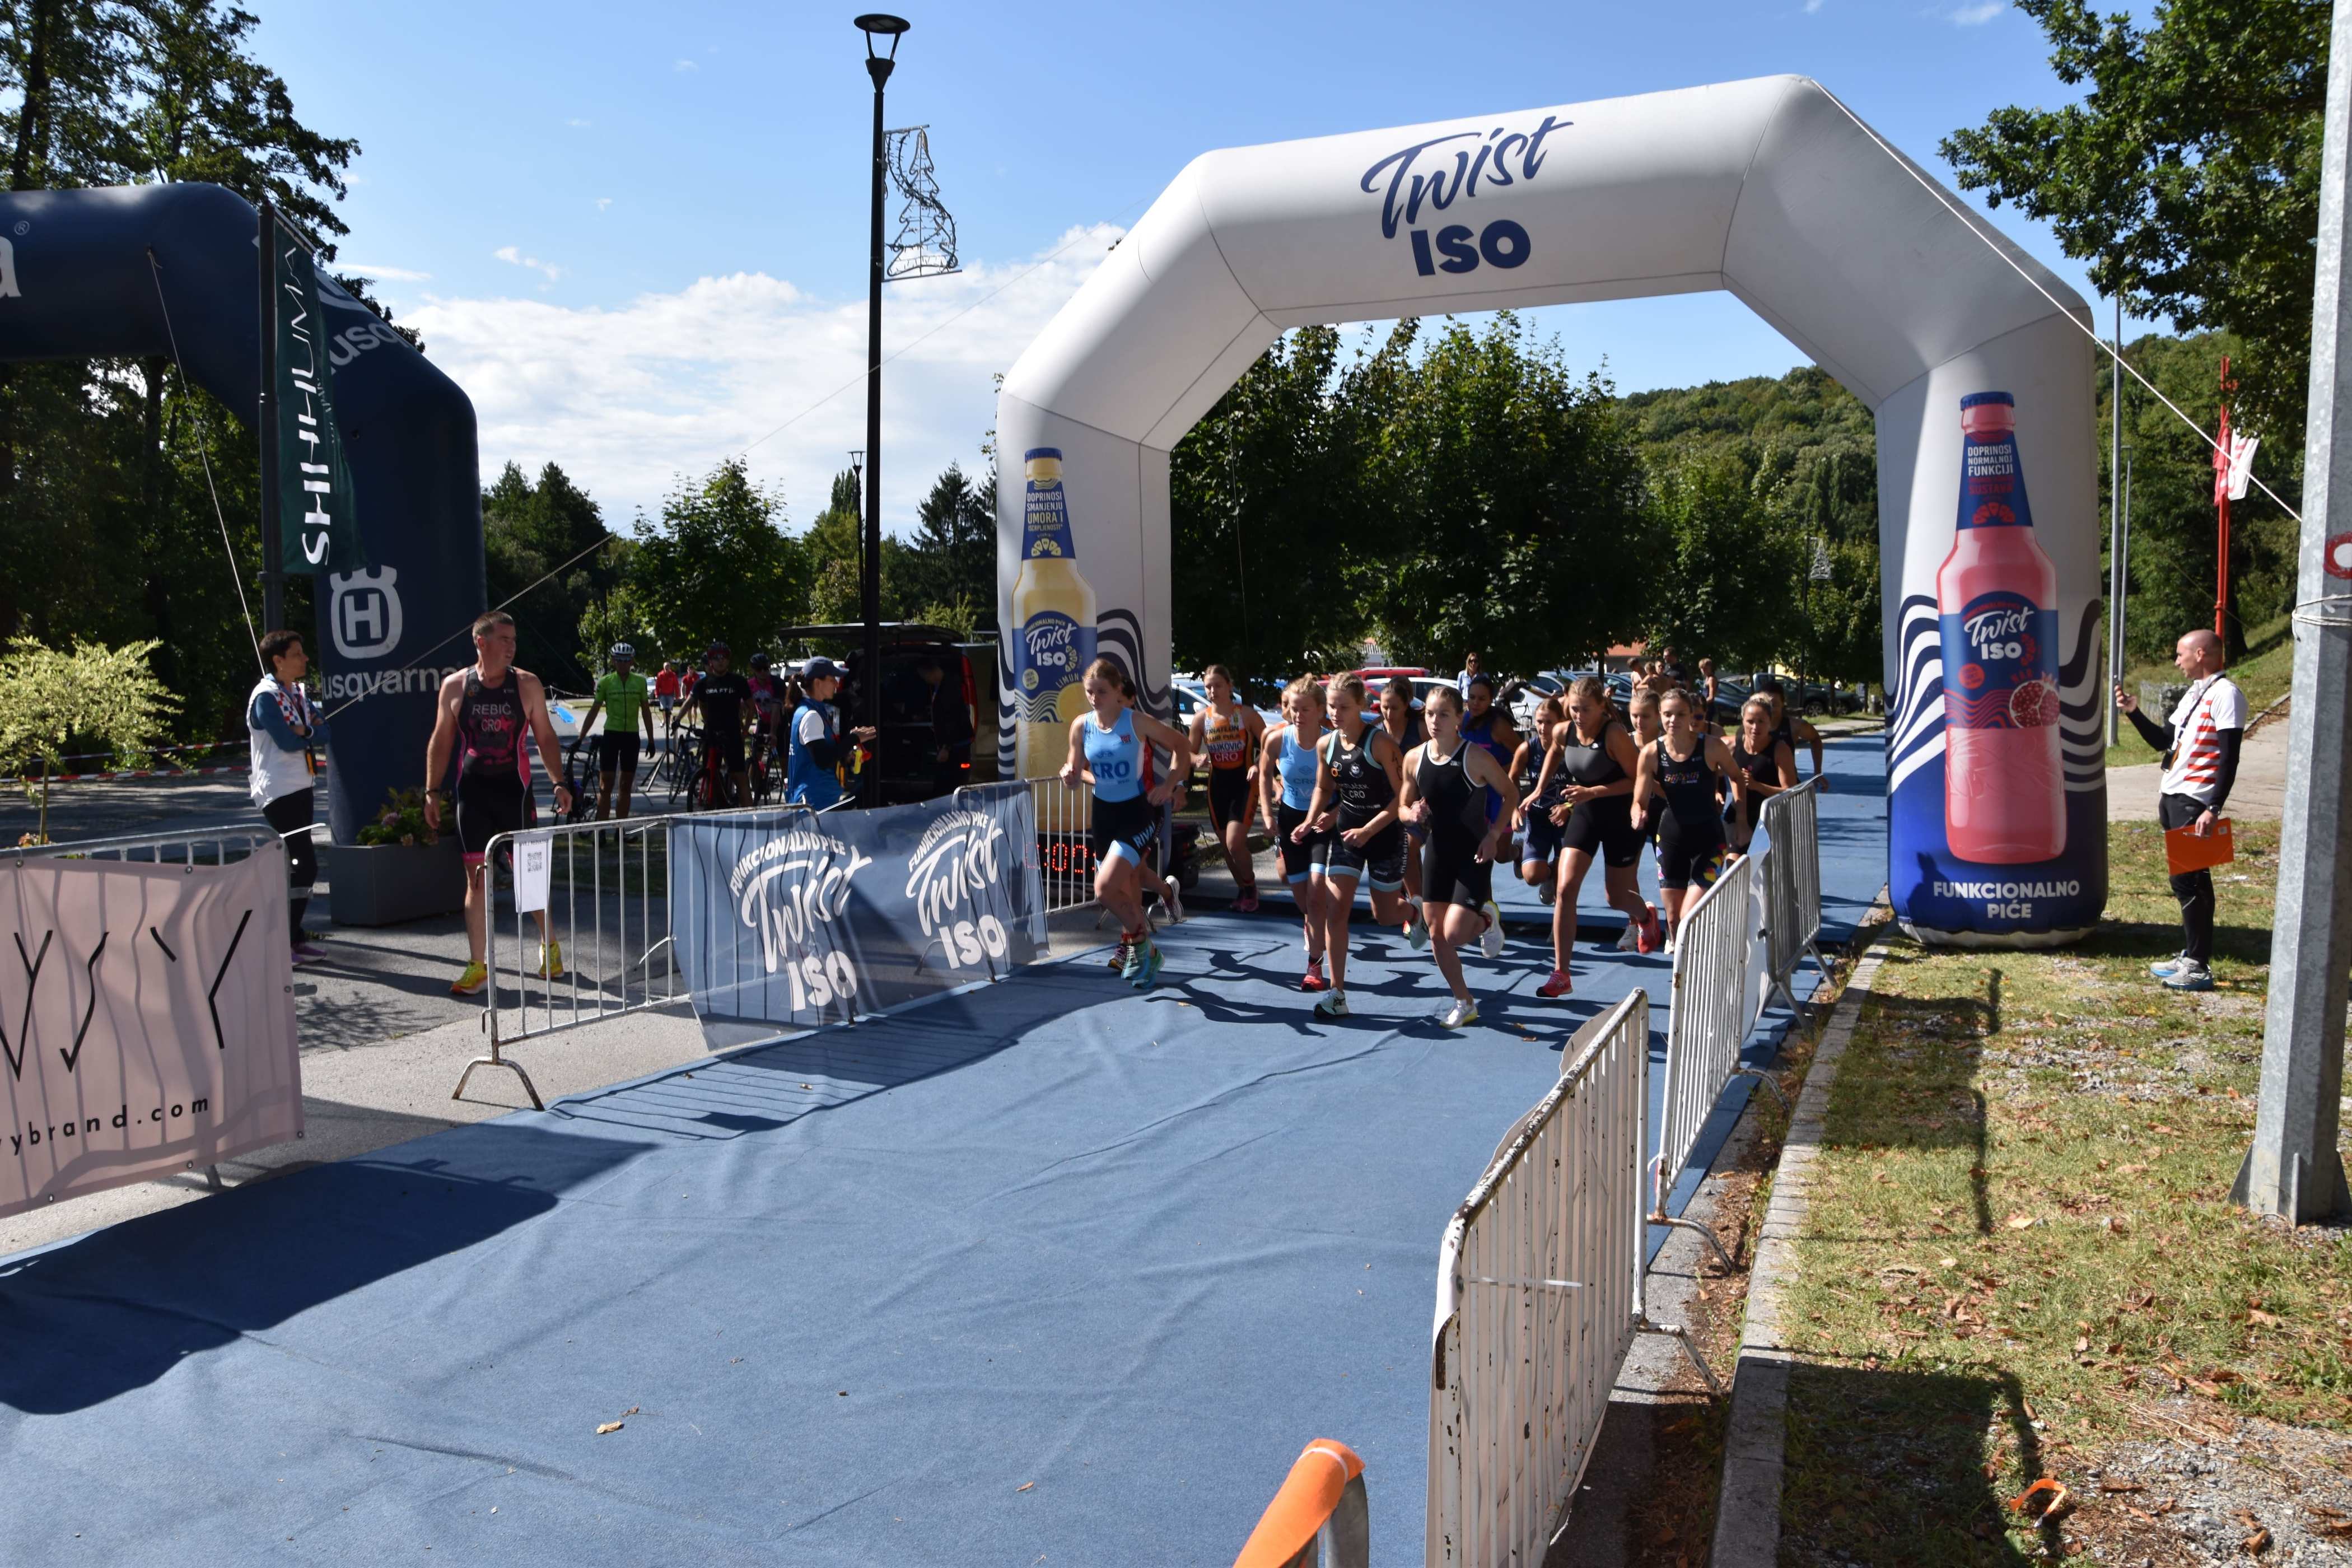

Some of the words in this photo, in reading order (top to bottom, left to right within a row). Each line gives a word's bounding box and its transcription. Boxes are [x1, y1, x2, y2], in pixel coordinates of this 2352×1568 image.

[1360, 116, 1574, 239] Twist
[1410, 220, 1531, 276] ISO
[1967, 445, 2012, 456] DOPRINOSI
[1968, 455, 2012, 465] NORMALNOJ
[1968, 464, 2013, 477] FUNKCIJI
[1027, 491, 1062, 502] DOPRINOSI
[1027, 502, 1063, 512] SMANJENJU
[1028, 512, 1057, 524] UMORA
[1060, 511, 1063, 523] I
[1964, 606, 2034, 647] Twist
[1026, 623, 1077, 655] Twist
[1037, 651, 1067, 666] ISO
[1981, 641, 2022, 660] ISO
[323, 666, 456, 702] usqvarn
[1055, 672, 1079, 688] LIMUN
[481, 718, 502, 732] CRO
[1214, 752, 1239, 762] CRO
[1091, 760, 1131, 780] CRO
[1349, 790, 1366, 799] CRO
[730, 831, 820, 897] FUNKCIONALNO
[906, 818, 1004, 937] Twist
[1934, 880, 2079, 899] FUNKCIONALNO
[741, 845, 872, 973] Twist
[1987, 899, 2032, 919] PIĆE
[939, 914, 1006, 969] ISO
[787, 950, 857, 1012] ISO
[0, 1098, 209, 1156] ybrand.com
